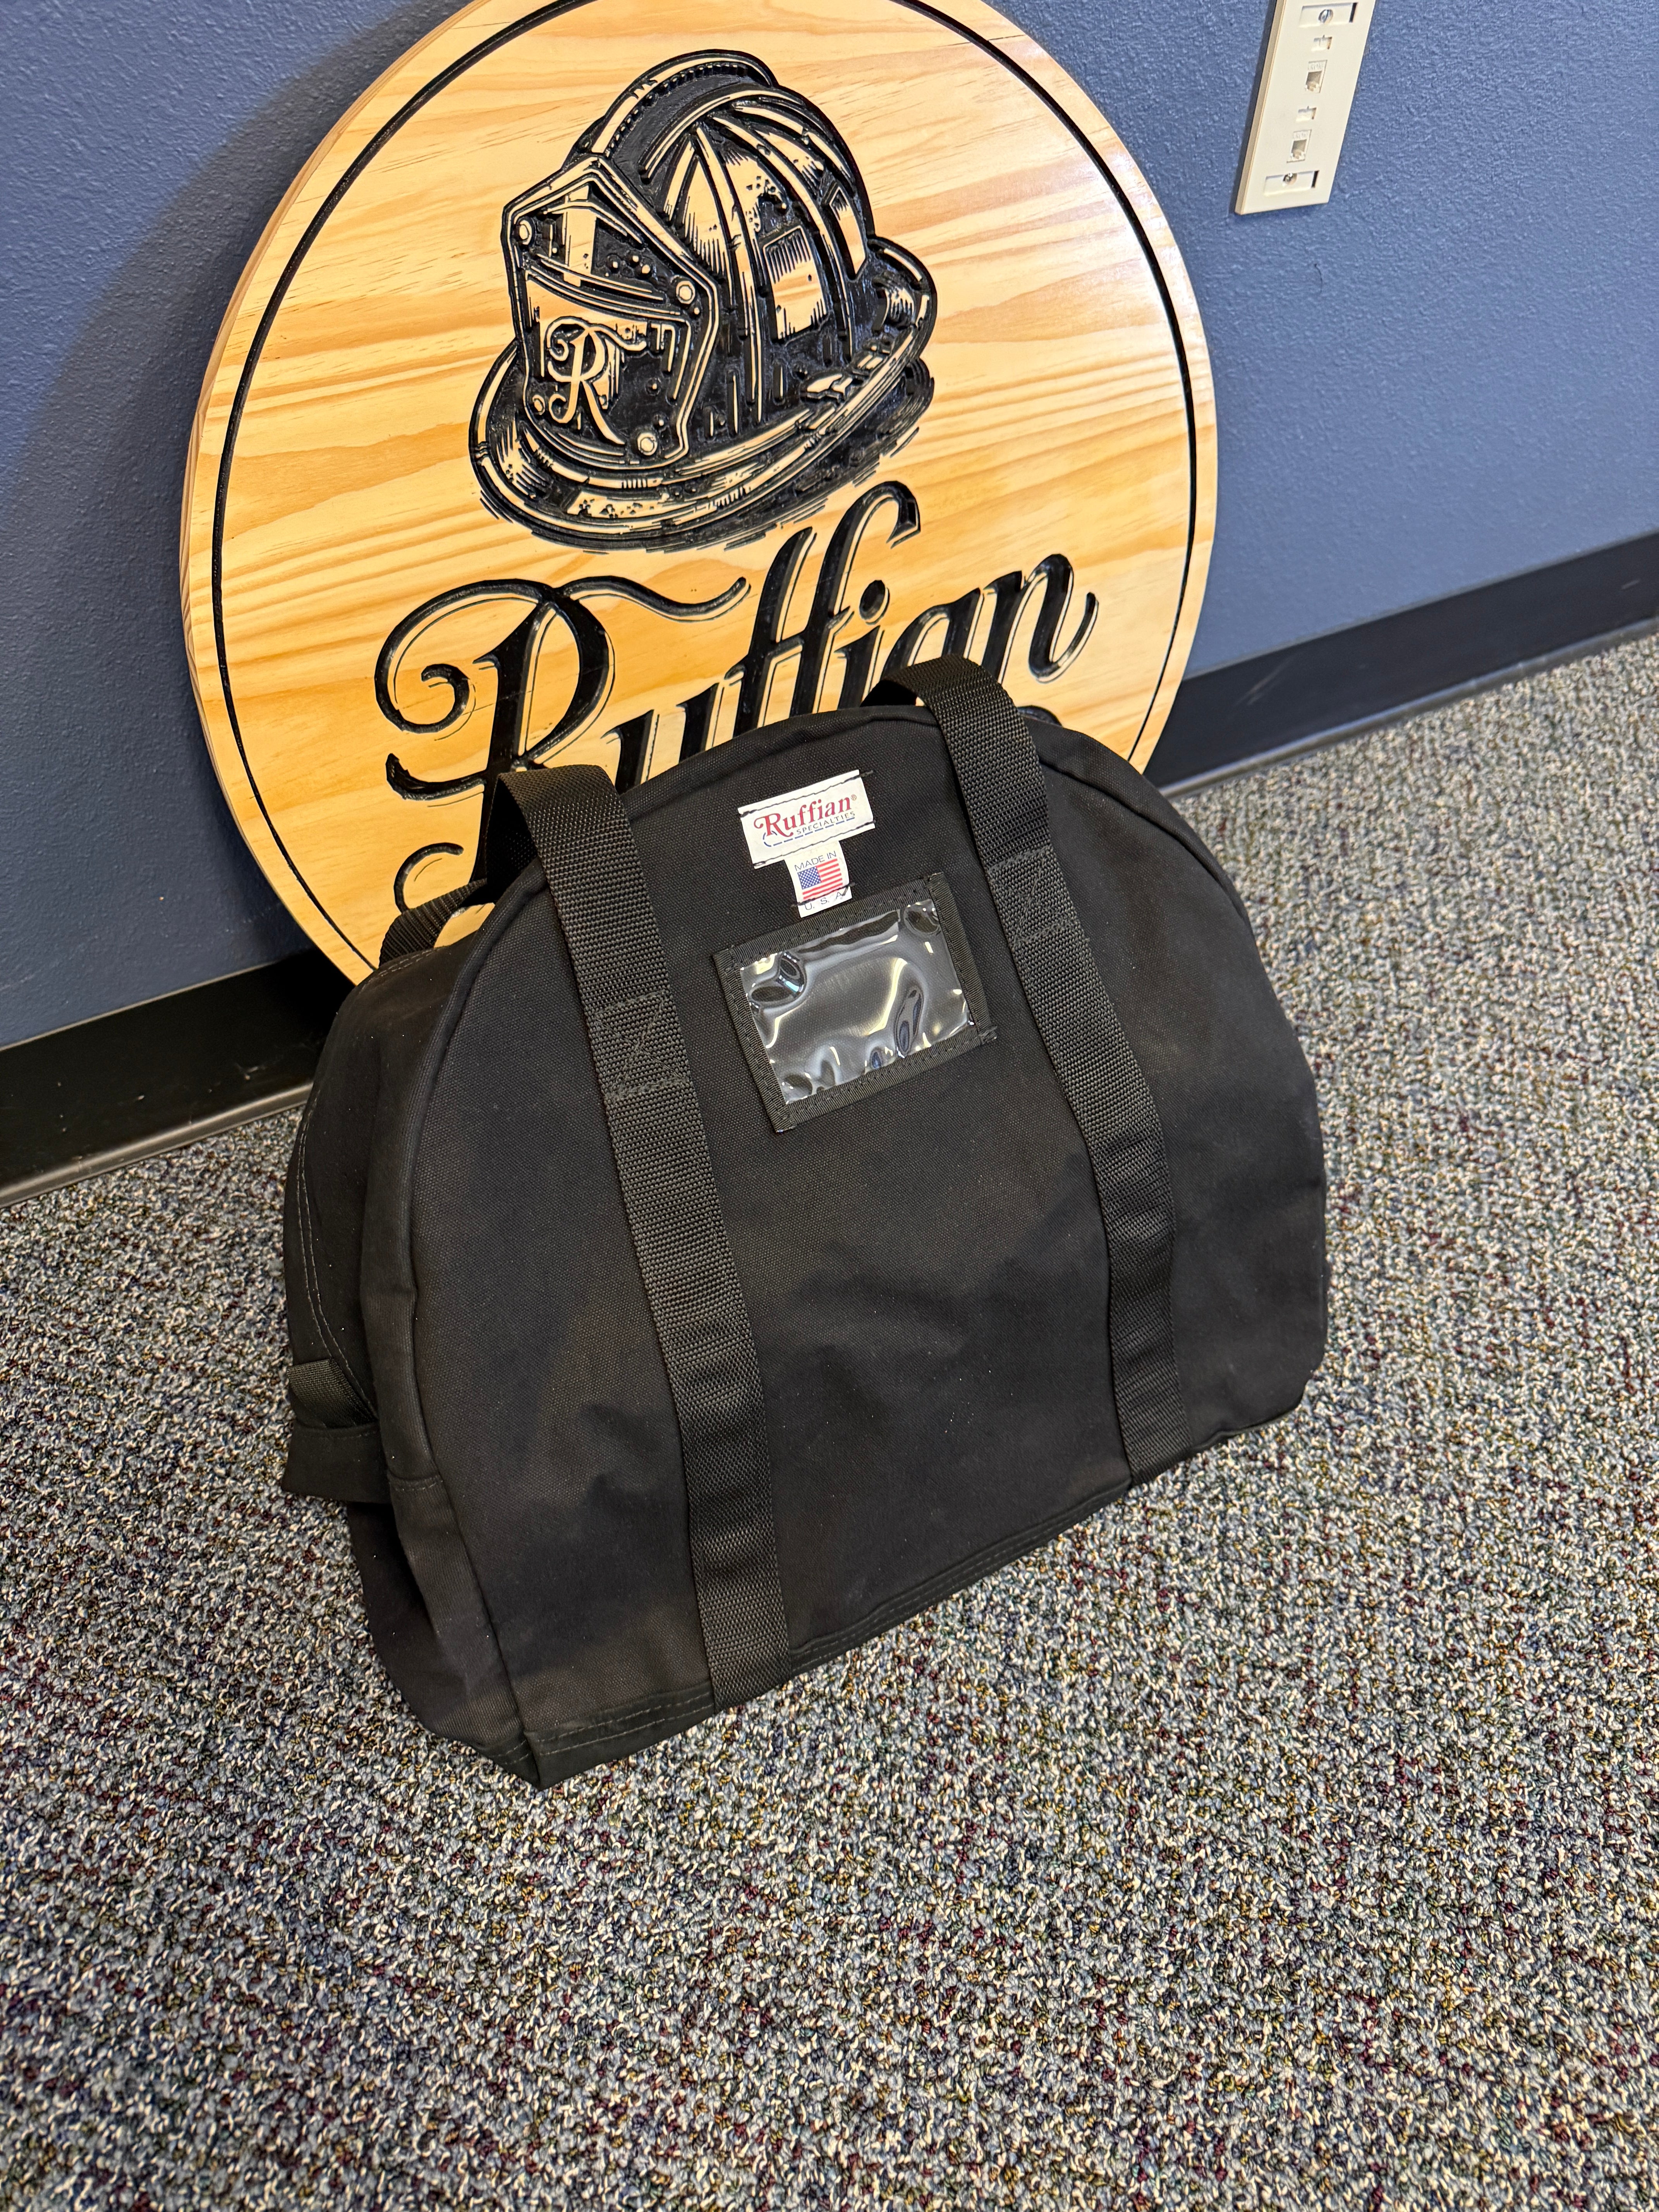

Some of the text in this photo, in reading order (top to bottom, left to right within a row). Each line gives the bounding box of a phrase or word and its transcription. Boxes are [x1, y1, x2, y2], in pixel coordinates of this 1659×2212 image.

[796, 811, 855, 835] SPECIALTIES
[794, 850, 837, 871] MADE IN
